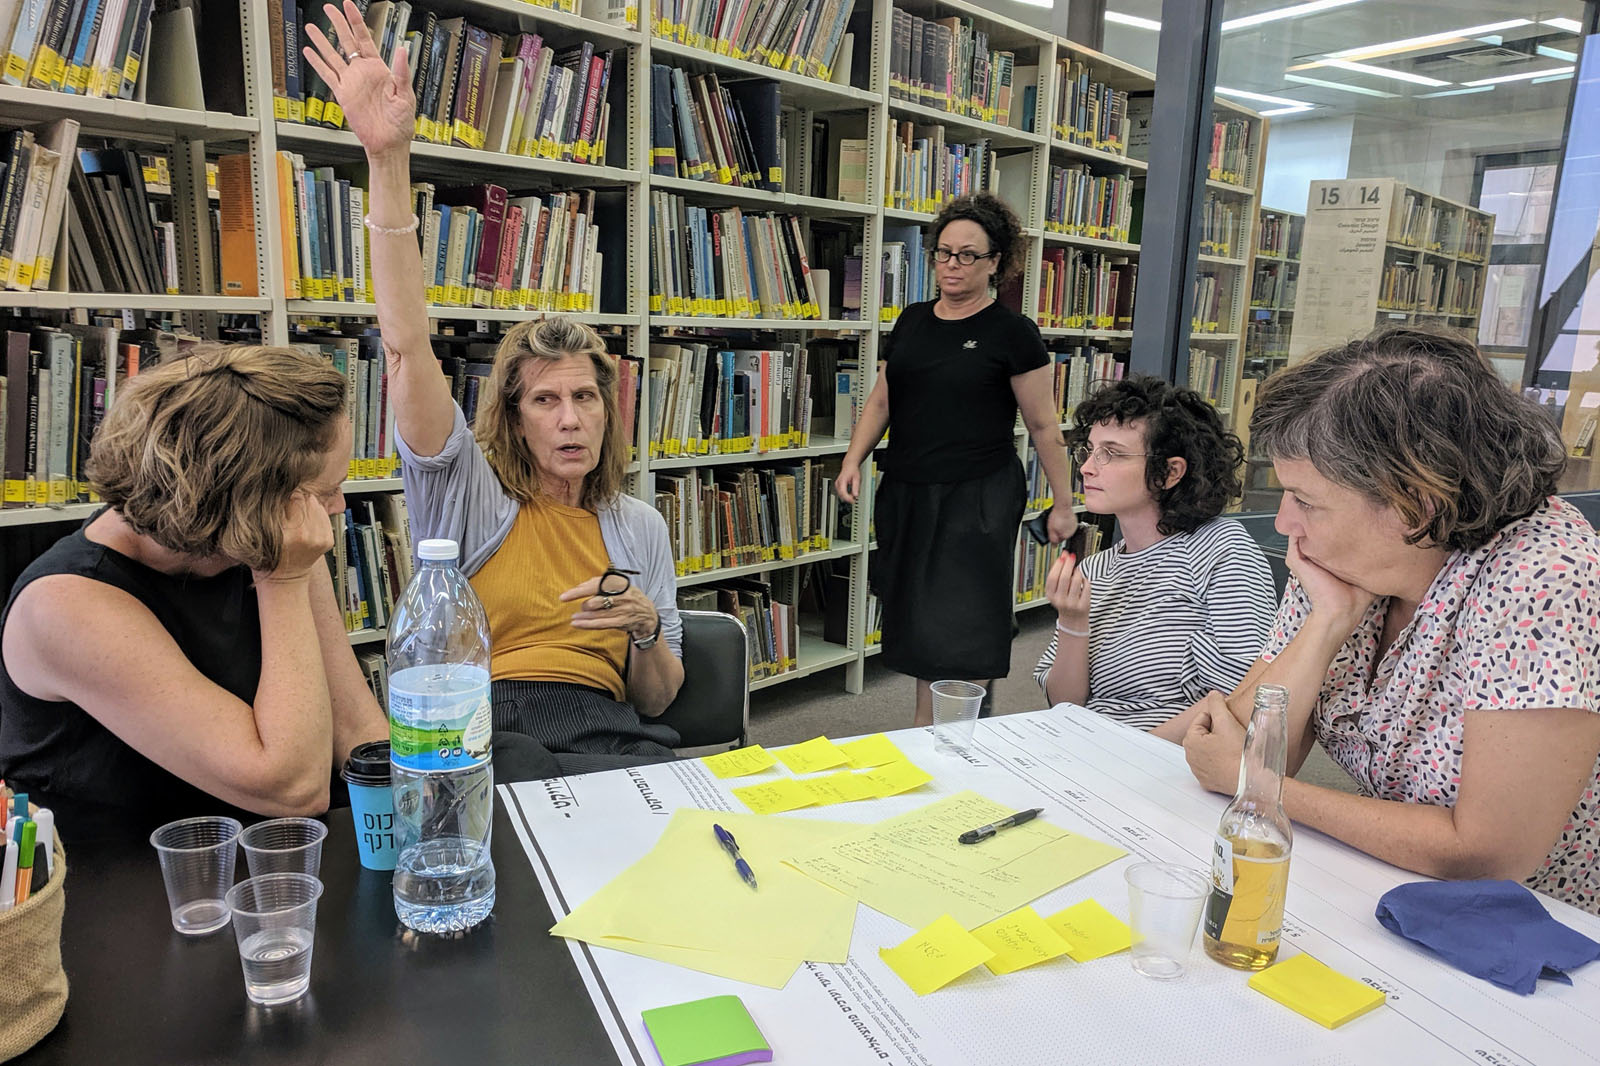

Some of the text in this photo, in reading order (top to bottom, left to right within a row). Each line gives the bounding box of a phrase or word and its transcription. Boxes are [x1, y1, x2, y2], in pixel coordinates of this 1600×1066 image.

[50, 18, 63, 48] Mariner
[286, 20, 297, 78] BOUCHERON
[424, 37, 432, 69] DIVIDED
[470, 54, 484, 86] THOMAS
[589, 87, 598, 97] THE
[585, 98, 596, 121] MODERN
[1321, 186, 1380, 205] 15 14
[350, 199, 362, 230] PENCIL
[712, 213, 721, 256] Cassina
[364, 813, 393, 830] כוס
[828, 988, 852, 1013] וערכים
[848, 1014, 889, 1060] פוטנציאליים
